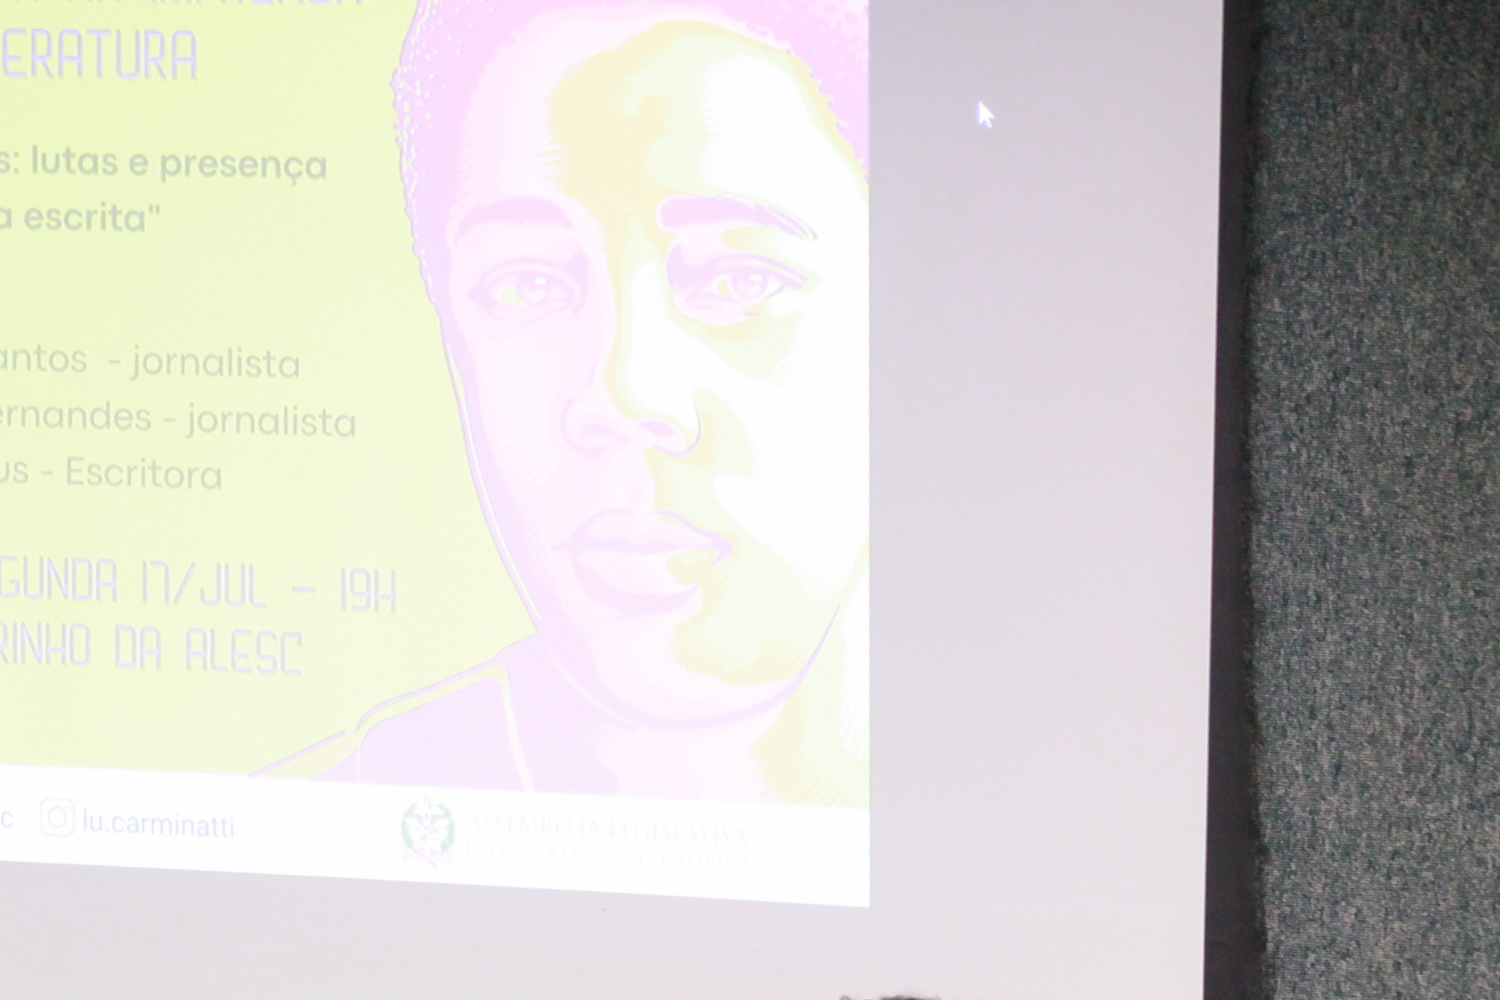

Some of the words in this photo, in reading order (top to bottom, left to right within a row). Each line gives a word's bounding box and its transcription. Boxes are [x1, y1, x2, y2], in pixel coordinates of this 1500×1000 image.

[32, 144, 119, 176] lutas
[128, 153, 149, 176] e
[160, 154, 327, 186] presença
[23, 201, 161, 232] escrita"
[130, 344, 300, 381] jornalista
[185, 402, 356, 439] jornalista
[66, 456, 222, 490] Escritora
[141, 560, 267, 608] 17/JUL
[340, 567, 397, 613] 19H
[114, 624, 162, 670] DA
[185, 627, 303, 676] ALESC
[82, 807, 235, 839] lu.carminatti
